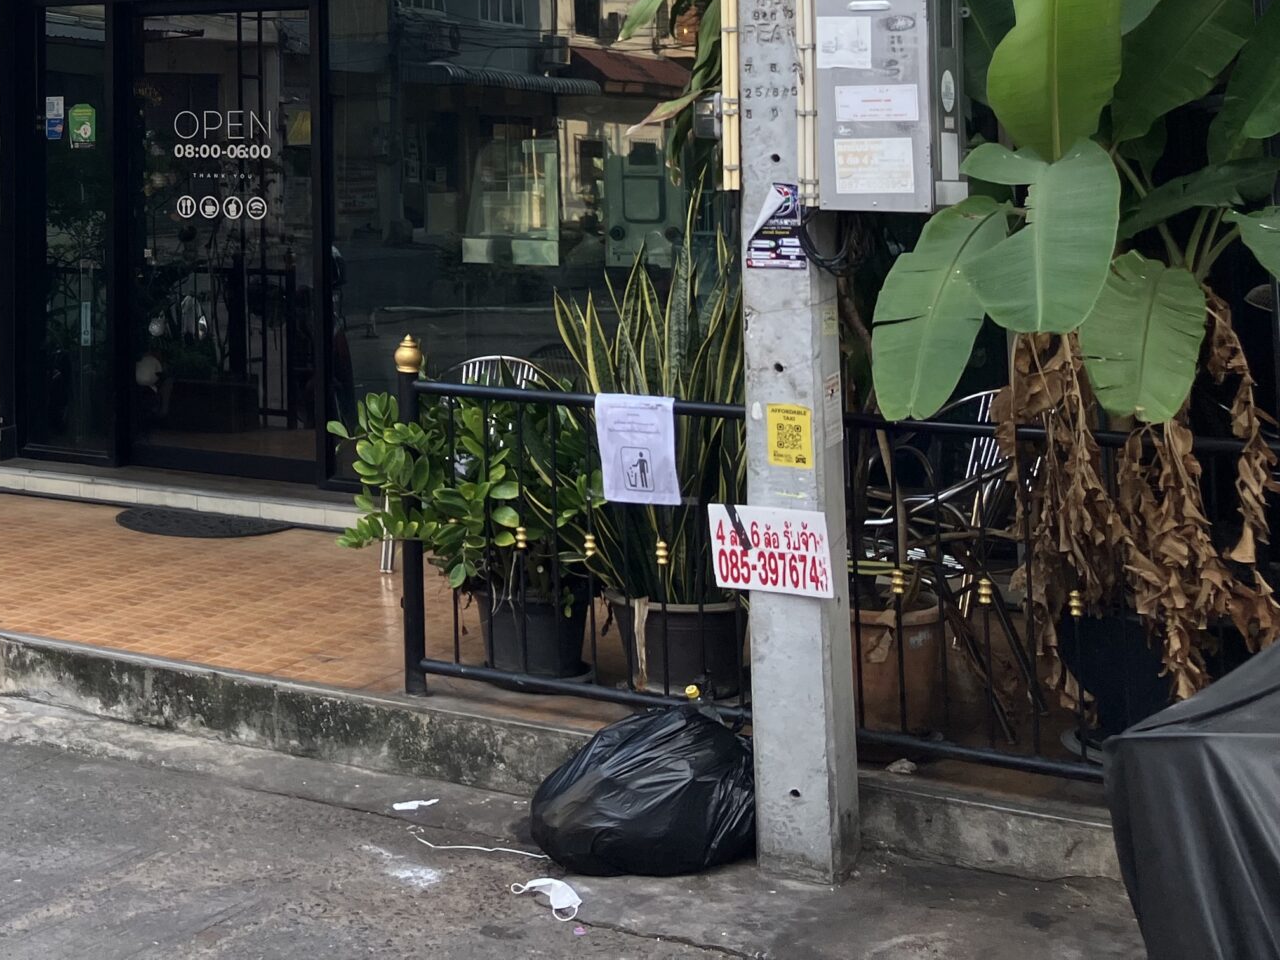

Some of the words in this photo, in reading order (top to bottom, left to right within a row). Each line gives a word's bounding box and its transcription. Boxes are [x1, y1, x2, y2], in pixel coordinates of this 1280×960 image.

[174, 110, 271, 139] OPEN
[174, 144, 272, 159] 08:00-06:00
[716, 520, 725, 546] 4
[750, 521, 760, 548] 6
[764, 524, 780, 549] ล้อ
